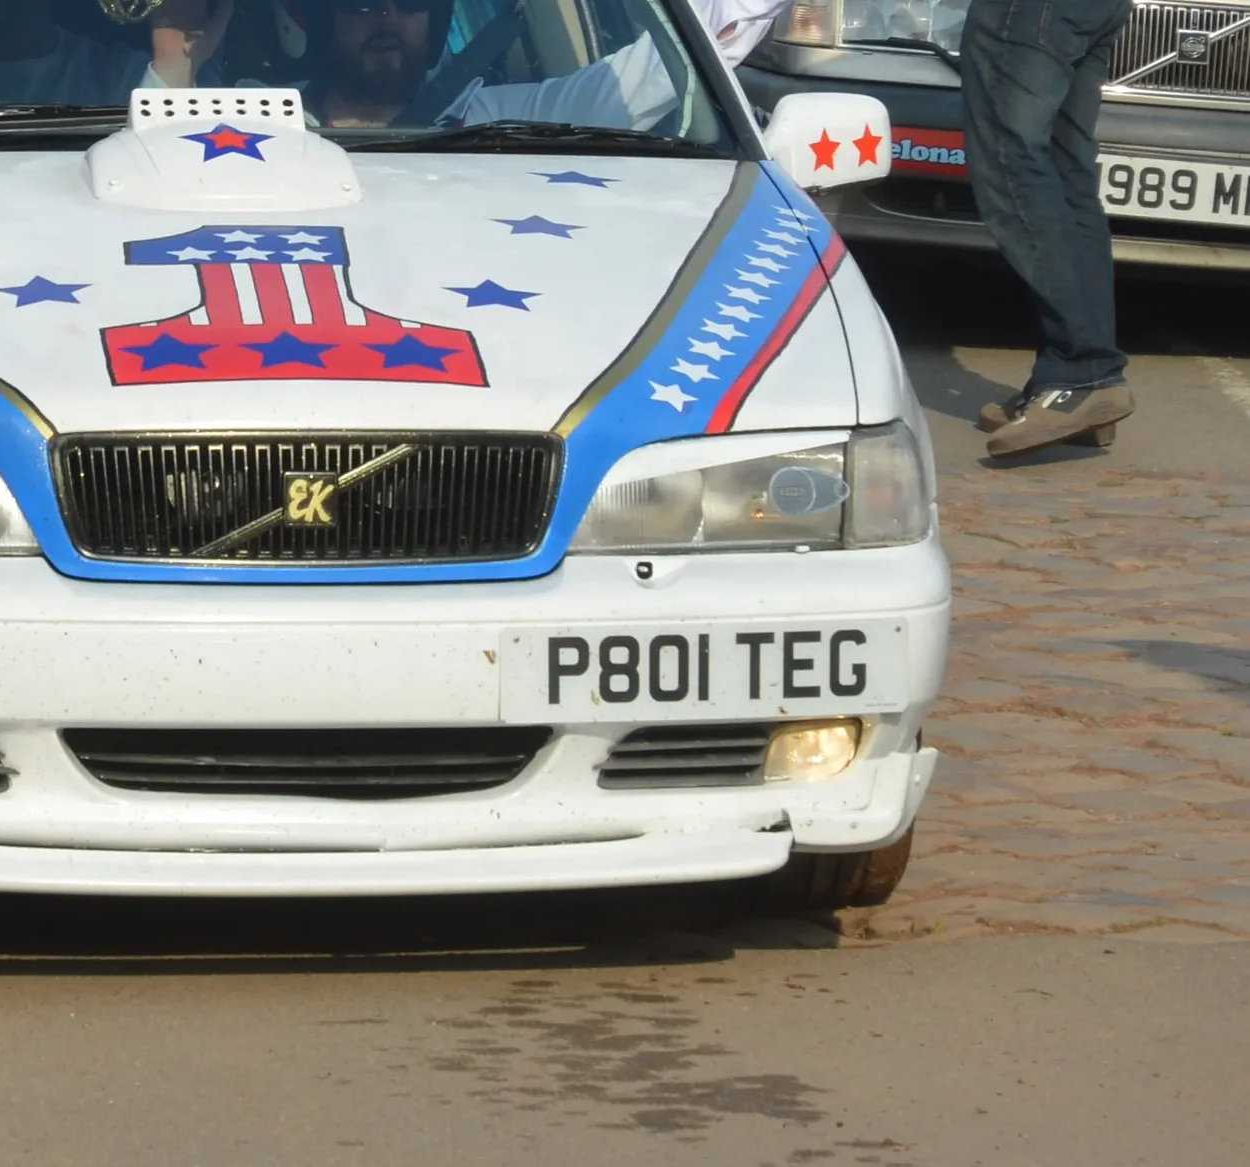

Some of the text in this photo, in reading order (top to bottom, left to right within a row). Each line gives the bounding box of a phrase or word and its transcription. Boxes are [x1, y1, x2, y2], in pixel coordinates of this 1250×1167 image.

[1096, 162, 1250, 216] 989 M
[548, 629, 867, 704] P801 TEG
